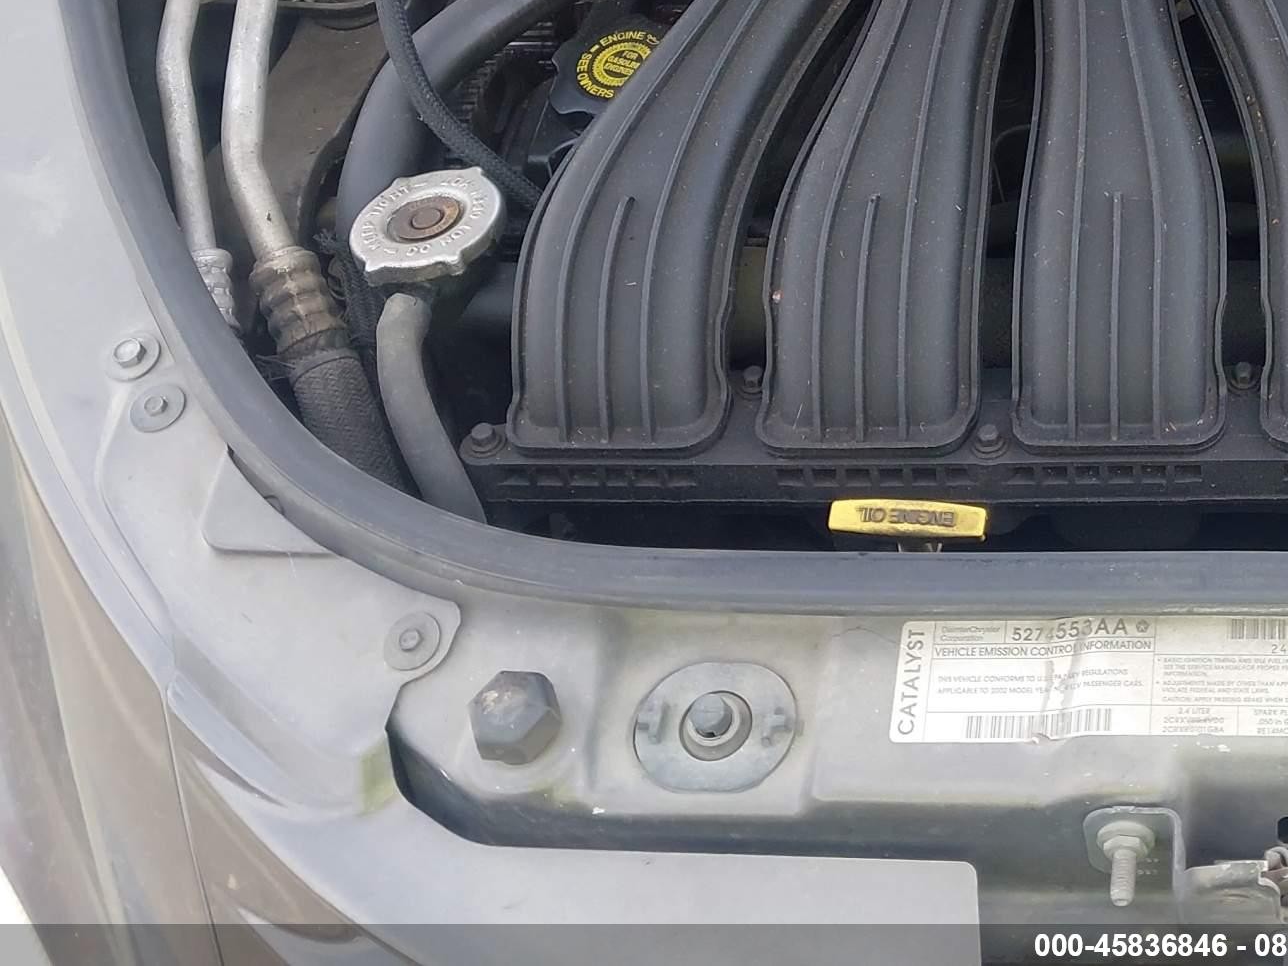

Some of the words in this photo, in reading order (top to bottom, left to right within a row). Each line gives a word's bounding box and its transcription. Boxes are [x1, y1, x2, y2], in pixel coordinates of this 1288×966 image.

[600, 31, 646, 46] ENGINE
[577, 52, 592, 73] SEE
[622, 50, 638, 60] FOR
[577, 72, 615, 98] OWNERS
[856, 506, 887, 523] OIL
[890, 508, 957, 527] ENGINE
[935, 646, 977, 657] VEHICLE
[978, 646, 1028, 657] EMISSION
[1030, 644, 1076, 656] CONTROL
[1079, 640, 1151, 651] INFORMATION
[898, 628, 926, 735] CATALYST
